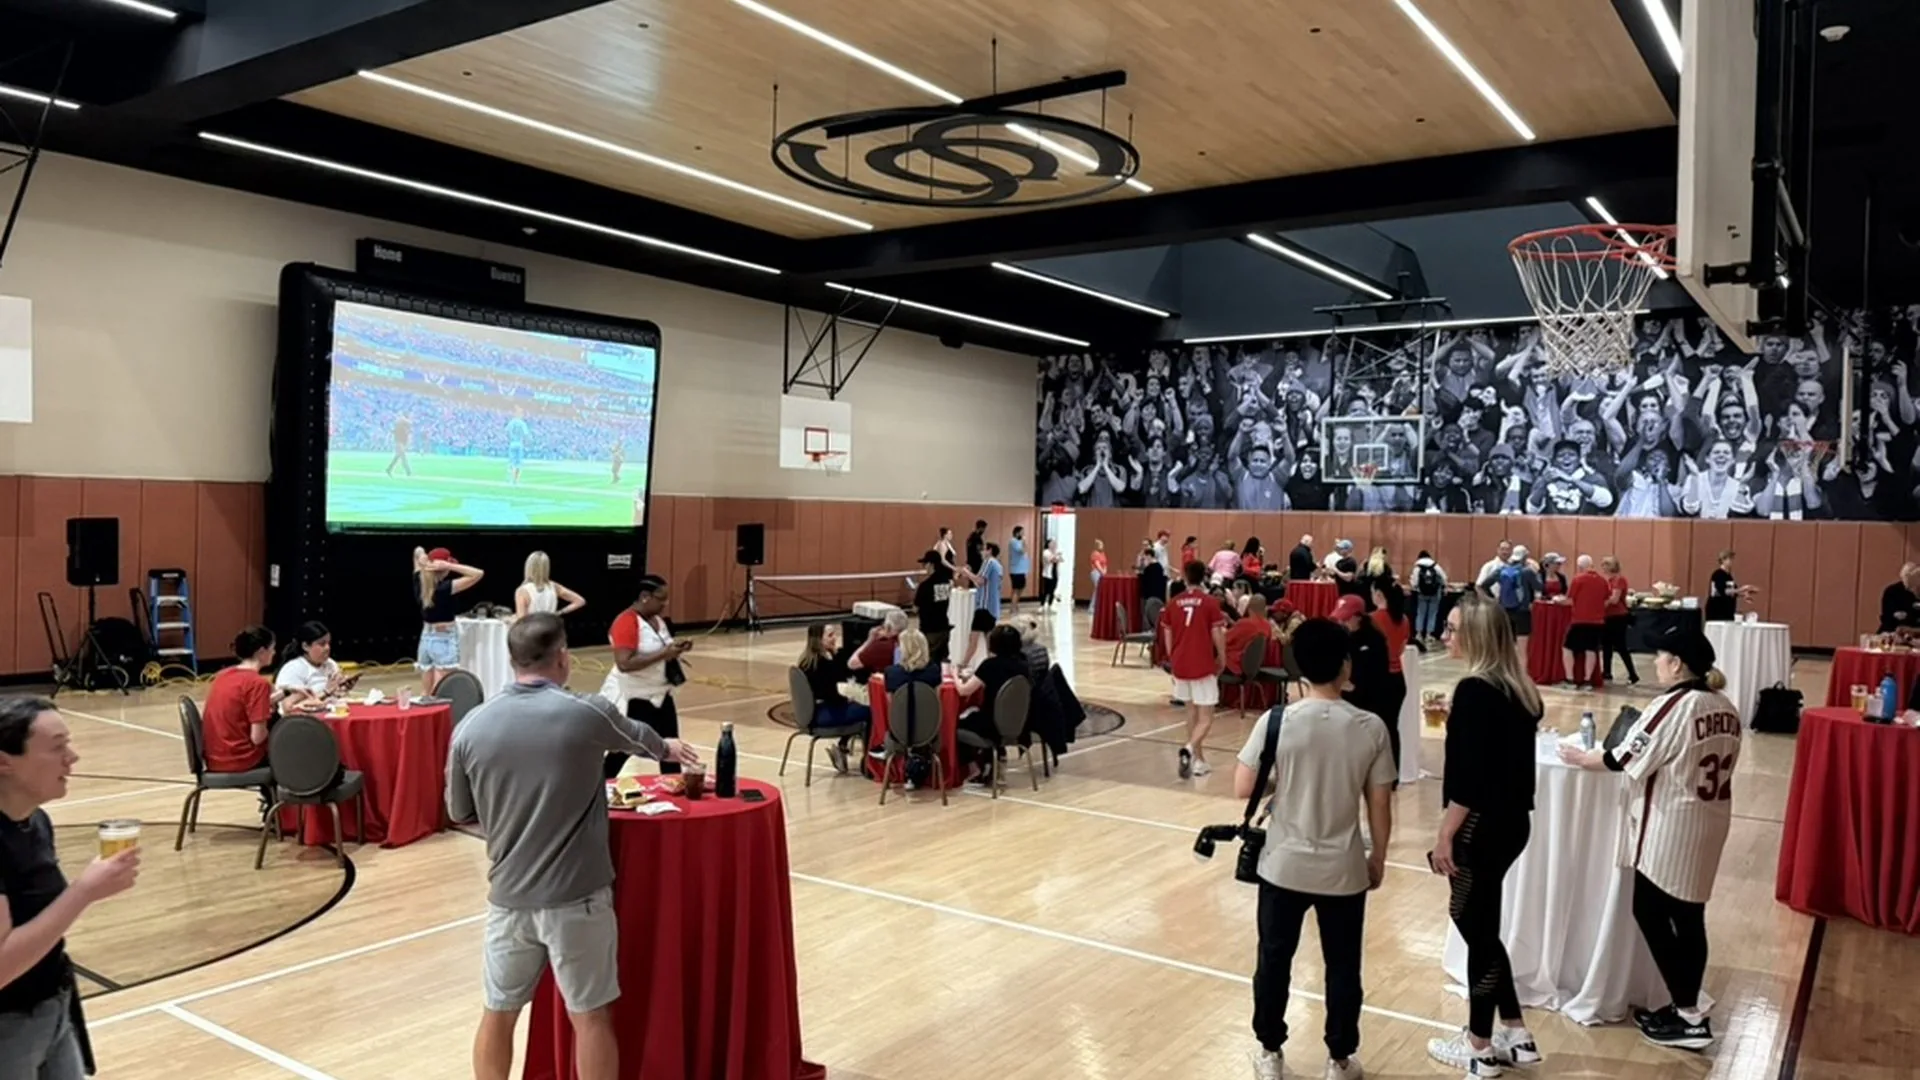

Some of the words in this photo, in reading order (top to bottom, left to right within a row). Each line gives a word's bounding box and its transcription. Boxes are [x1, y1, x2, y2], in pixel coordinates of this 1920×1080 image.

[374, 244, 403, 262] Home
[1184, 607, 1194, 627] 7
[1697, 753, 1732, 801] 32
